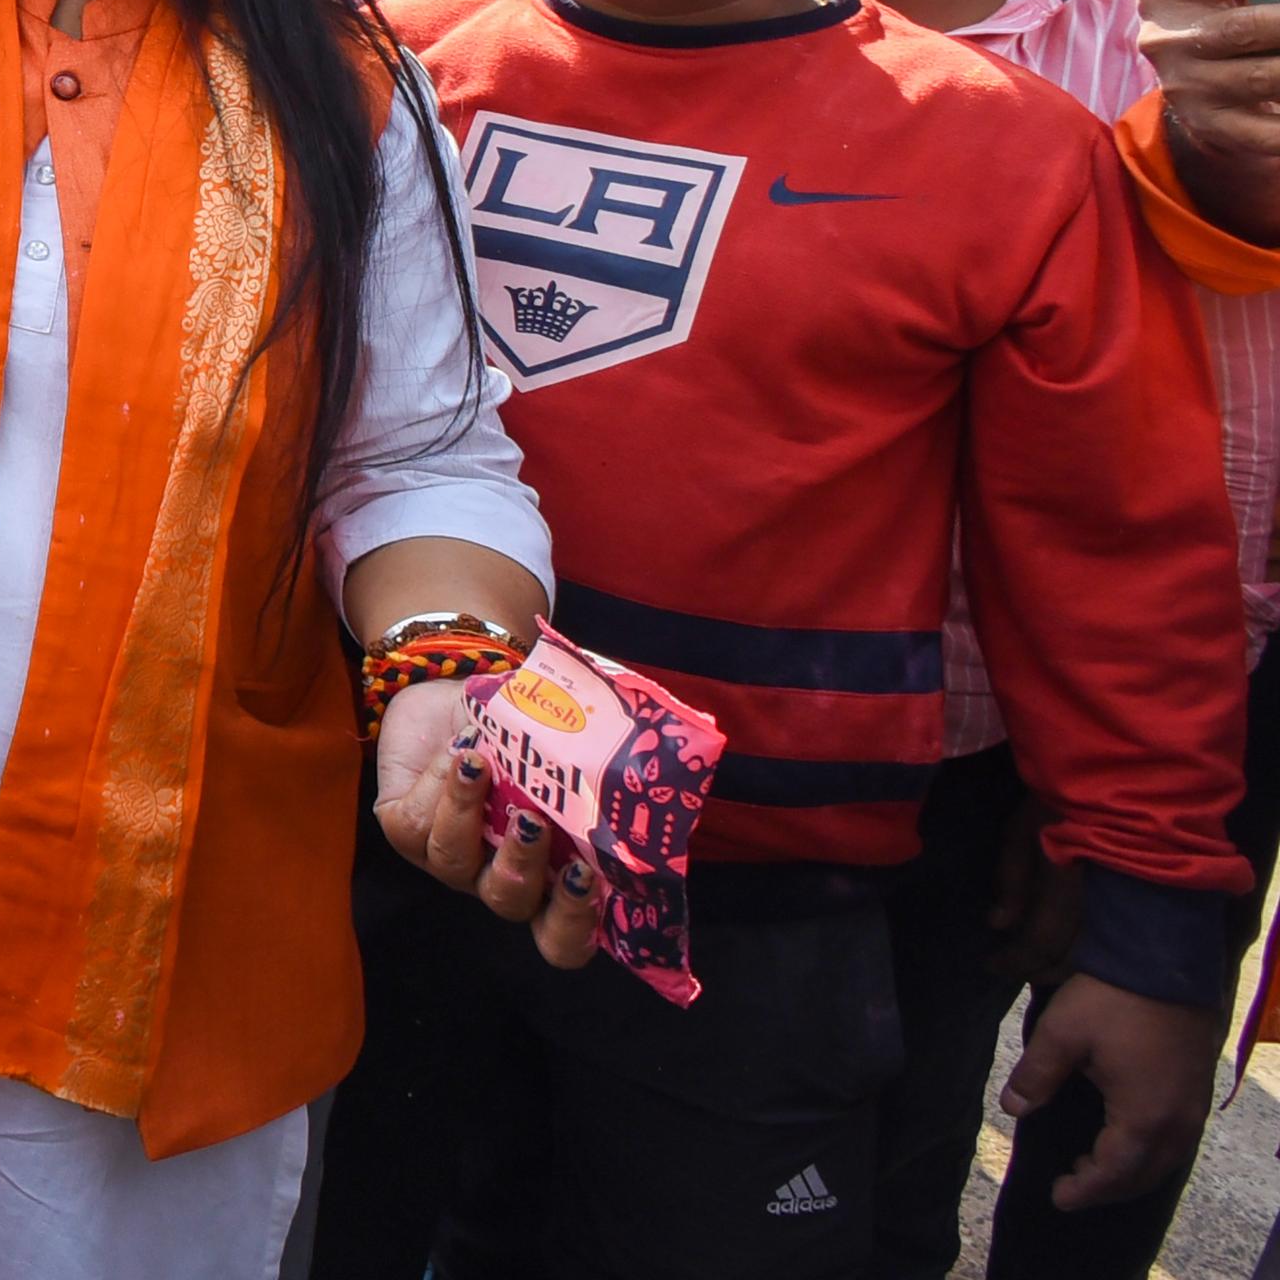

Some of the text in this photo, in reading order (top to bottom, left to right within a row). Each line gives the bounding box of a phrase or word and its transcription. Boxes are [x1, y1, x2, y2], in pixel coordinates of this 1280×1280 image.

[473, 147, 698, 250] LA
[506, 676, 578, 728] akesh
[485, 733, 566, 816] ulal
[766, 1195, 838, 1216] adidas
